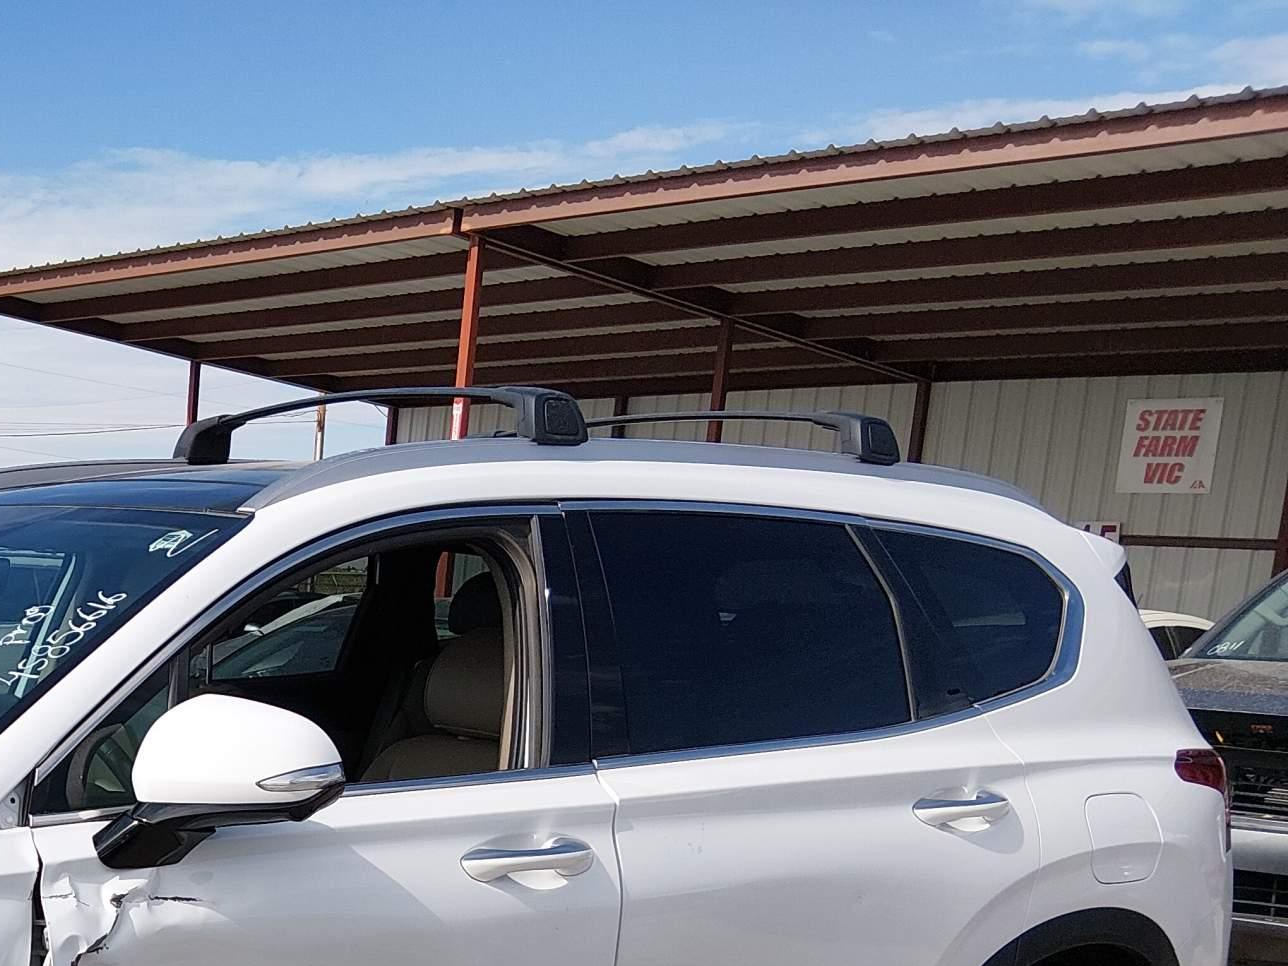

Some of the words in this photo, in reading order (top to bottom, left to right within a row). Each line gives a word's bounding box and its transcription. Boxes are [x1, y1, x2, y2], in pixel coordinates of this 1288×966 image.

[1135, 408, 1208, 432] STATE
[1132, 435, 1201, 458] FARM
[1143, 462, 1185, 485] VIC
